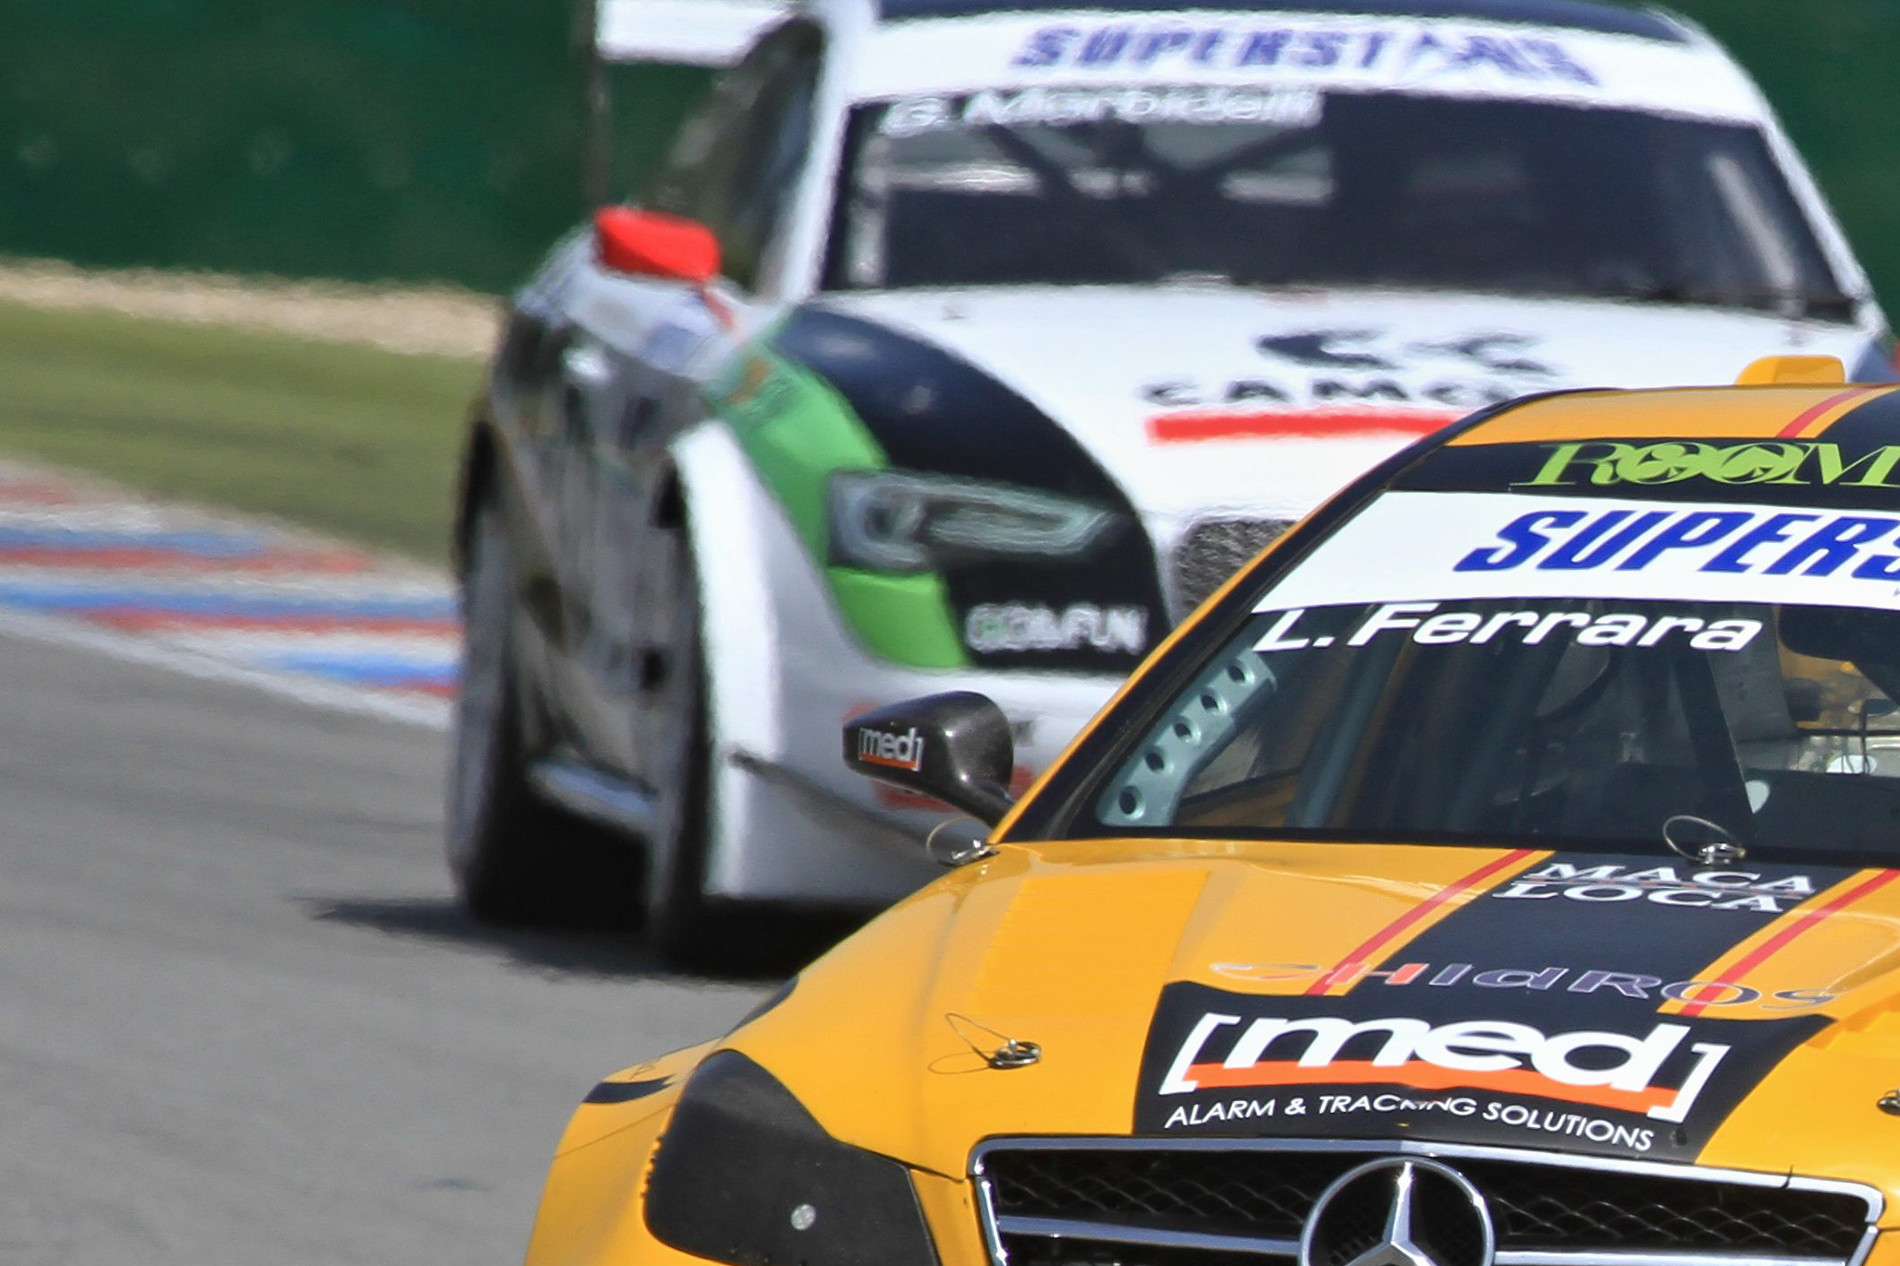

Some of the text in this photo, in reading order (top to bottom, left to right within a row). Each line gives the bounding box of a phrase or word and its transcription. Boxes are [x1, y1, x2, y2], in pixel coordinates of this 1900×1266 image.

[1522, 862, 1814, 895] MACA
[1492, 882, 1784, 914] LOCA
[1165, 1099, 1278, 1128] ALARM
[1286, 1098, 1306, 1116] &
[1482, 1101, 1655, 1151] SOLUTIONS
